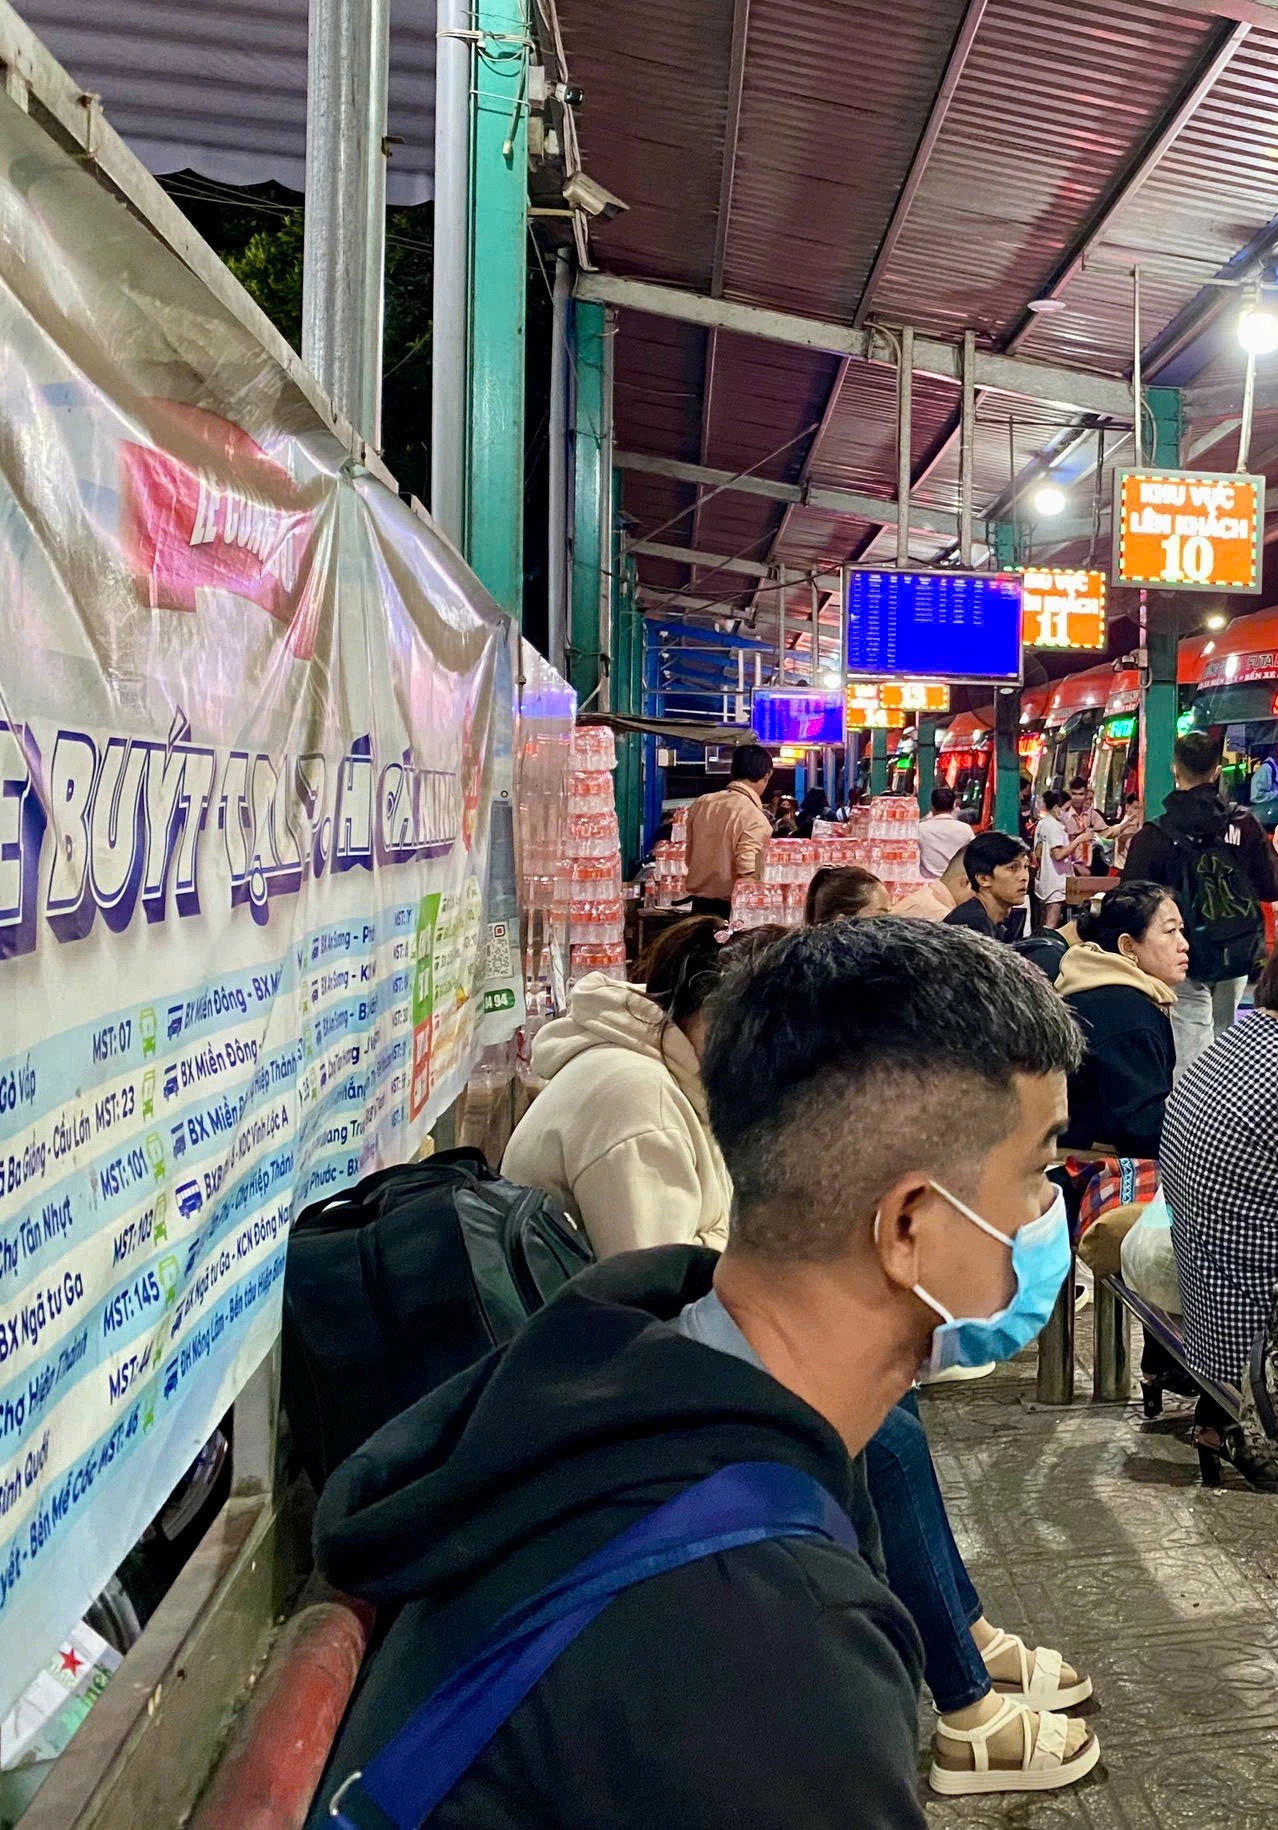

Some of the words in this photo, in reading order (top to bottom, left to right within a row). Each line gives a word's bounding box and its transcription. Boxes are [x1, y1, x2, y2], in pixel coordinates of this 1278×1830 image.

[1140, 483, 1186, 506] KHU
[1129, 507, 1172, 534] LÊN
[1160, 534, 1214, 580] 10
[1036, 612, 1071, 646] 11
[1248, 653, 1273, 669] FUTA
[1263, 671, 1276, 680] XE
[46, 705, 216, 930] BUÝT
[213, 986, 248, 1015] Đông
[252, 976, 272, 1001] BX
[493, 993, 508, 1008] 94
[93, 1028, 117, 1065] MST:
[119, 1020, 131, 1053] 07
[181, 1058, 193, 1088] BX
[197, 1041, 227, 1080] Miền
[225, 1038, 258, 1070] Đông
[7, 1156, 22, 1192] Ba
[95, 1093, 120, 1133] MST:
[121, 1085, 135, 1118] 23
[187, 1117, 210, 1146] BX
[19, 1216, 42, 1258] Tân
[100, 1156, 130, 1200] MST:
[128, 1147, 149, 1175] 101
[21, 1293, 46, 1345] Ngã
[64, 1272, 83, 1306] Ga
[113, 1223, 137, 1268] MST:
[104, 1290, 134, 1337] MST:
[134, 1272, 160, 1311] 145
